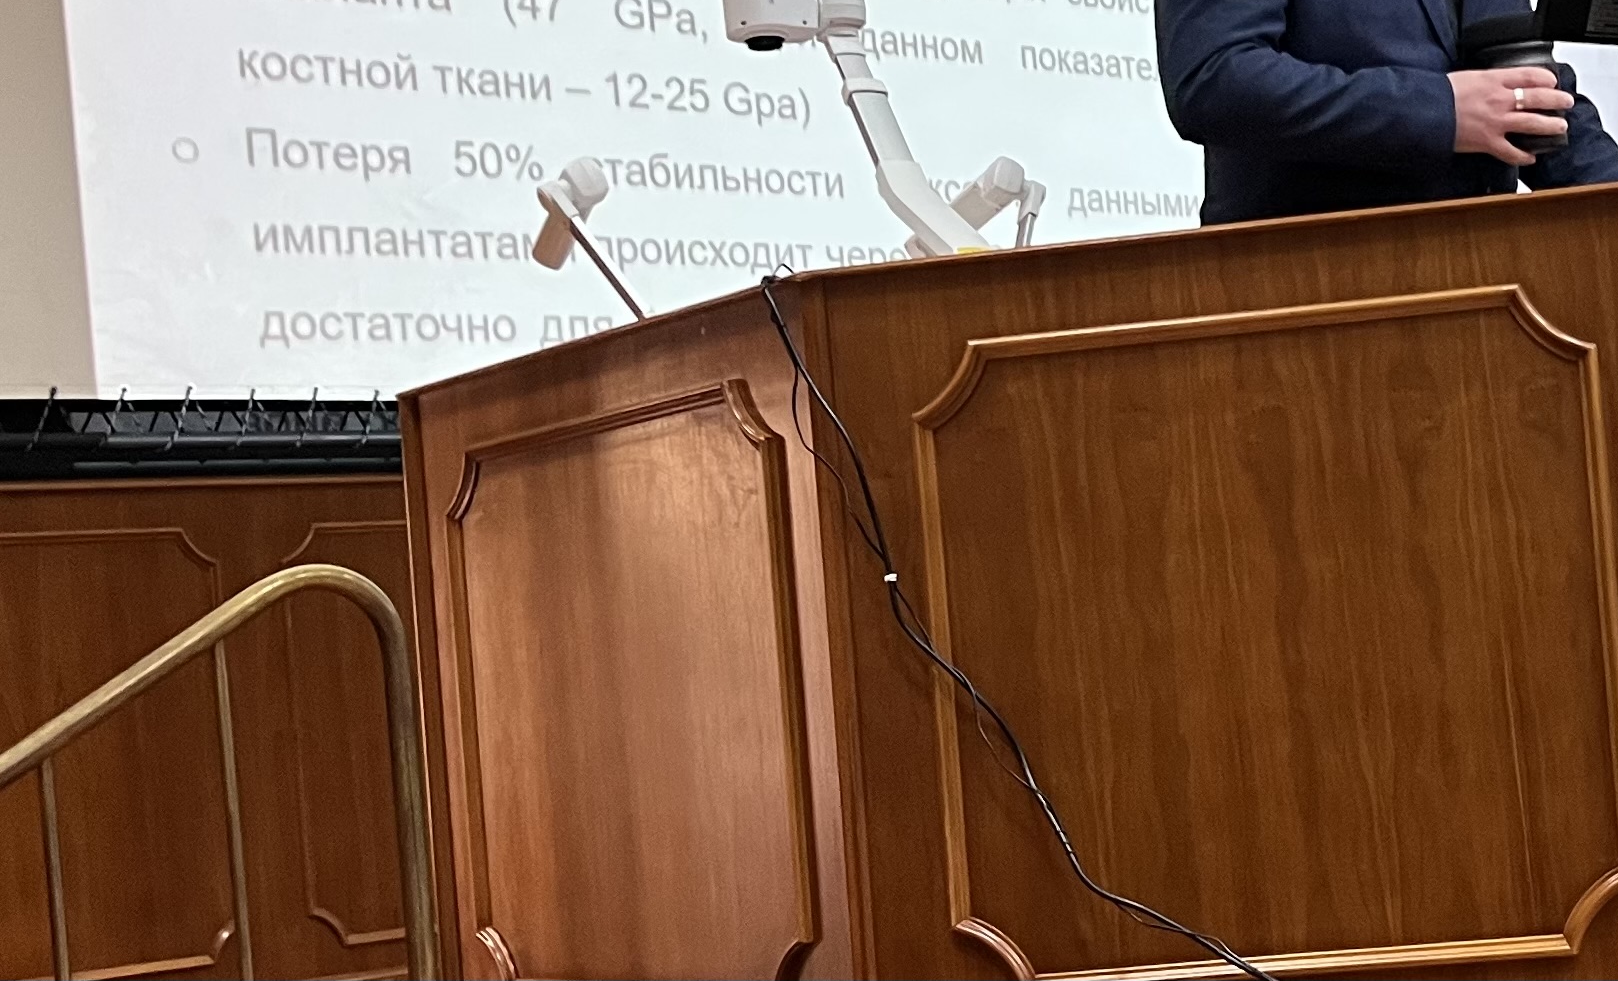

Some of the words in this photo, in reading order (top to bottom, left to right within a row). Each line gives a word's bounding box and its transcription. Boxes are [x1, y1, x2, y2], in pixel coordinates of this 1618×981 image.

[862, 28, 983, 64] данном
[1021, 45, 1158, 82] показате
[237, 48, 419, 92] костной
[433, 64, 551, 103] ткани
[605, 72, 710, 113] 12-25
[723, 82, 810, 129] Gpa)
[246, 127, 411, 181] Потеря
[454, 140, 543, 181] 50%
[593, 153, 845, 198] табильности
[1068, 187, 1200, 218] данными
[253, 221, 576, 264] имплантата
[260, 311, 516, 348] достаточно
